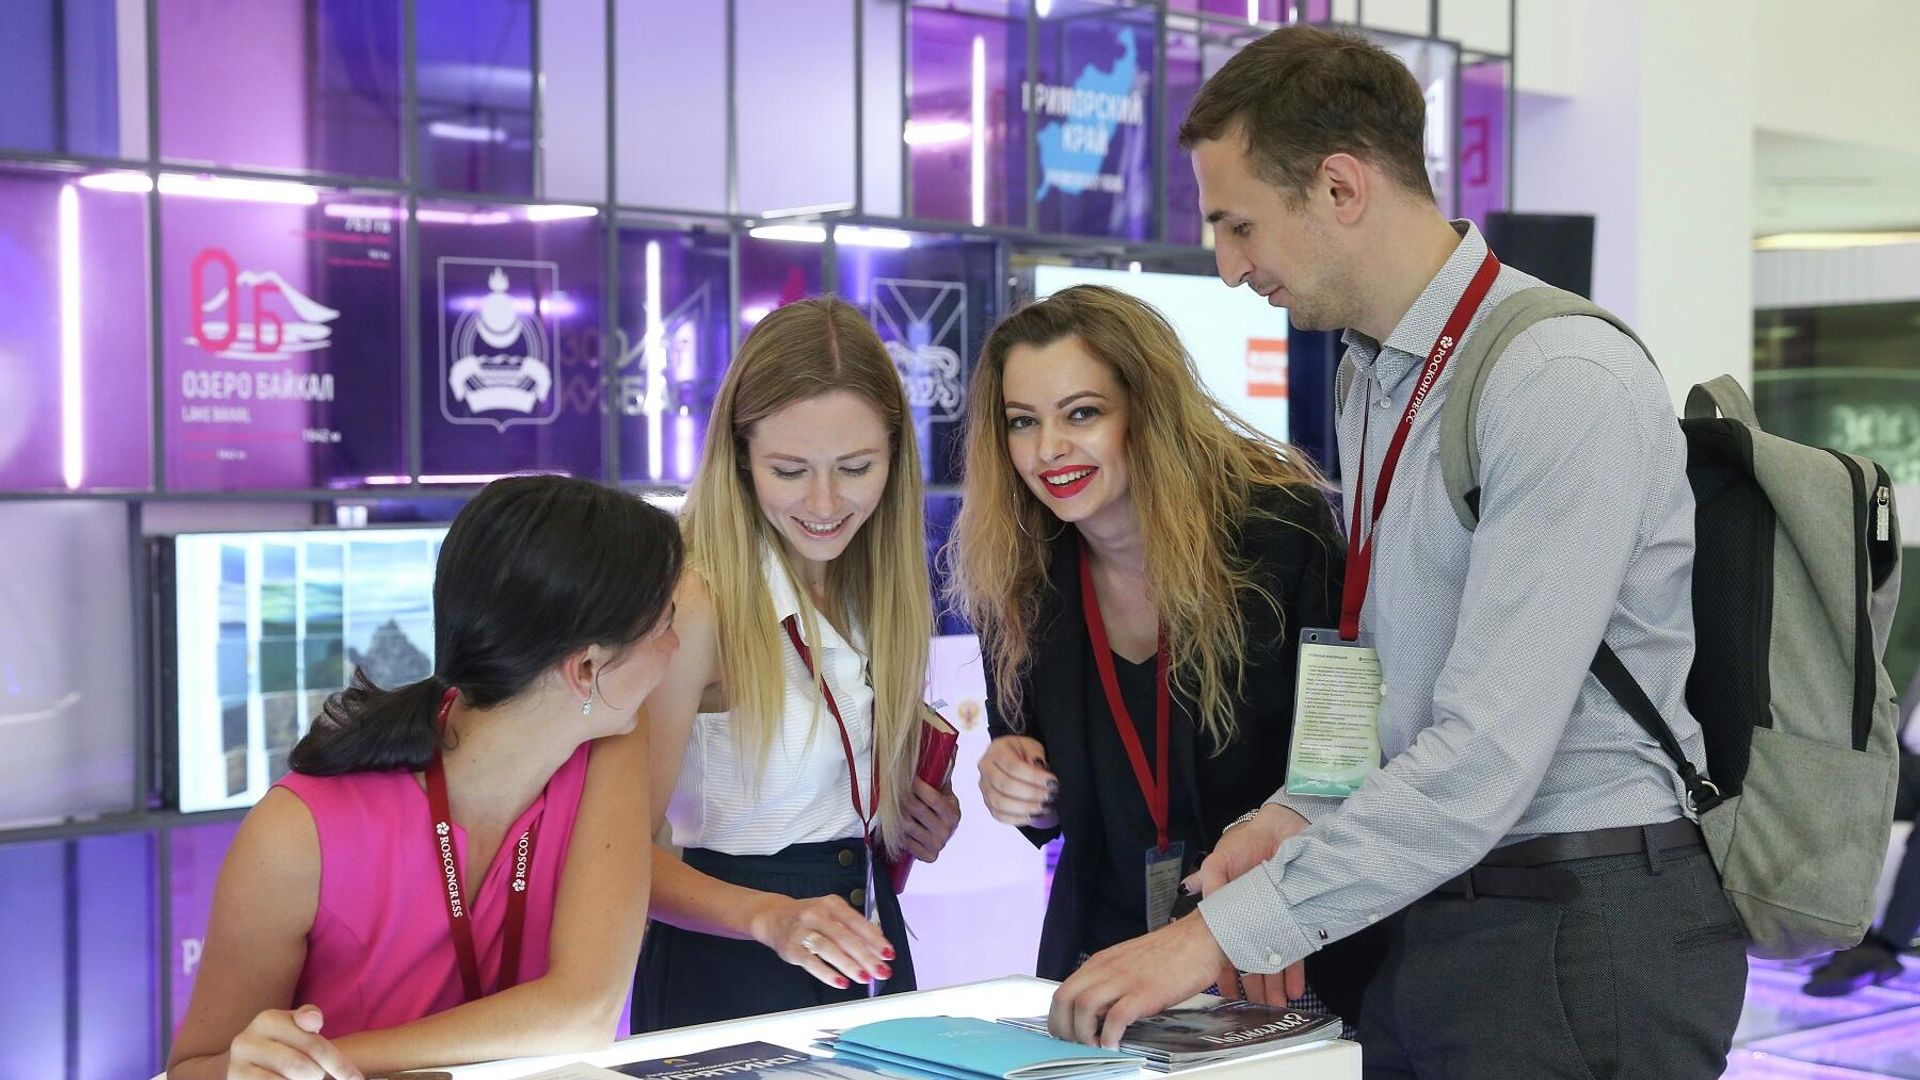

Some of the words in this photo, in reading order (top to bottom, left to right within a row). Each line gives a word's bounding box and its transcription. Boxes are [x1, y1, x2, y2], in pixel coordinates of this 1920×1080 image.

[1062, 121, 1109, 157] КРАЙ
[181, 369, 251, 400] ОЗЕРО
[255, 368, 335, 402] БАЙКАЛ
[1405, 347, 1447, 425] РОСКОНГРЕСС
[439, 835, 463, 918] ROSCONGRESS
